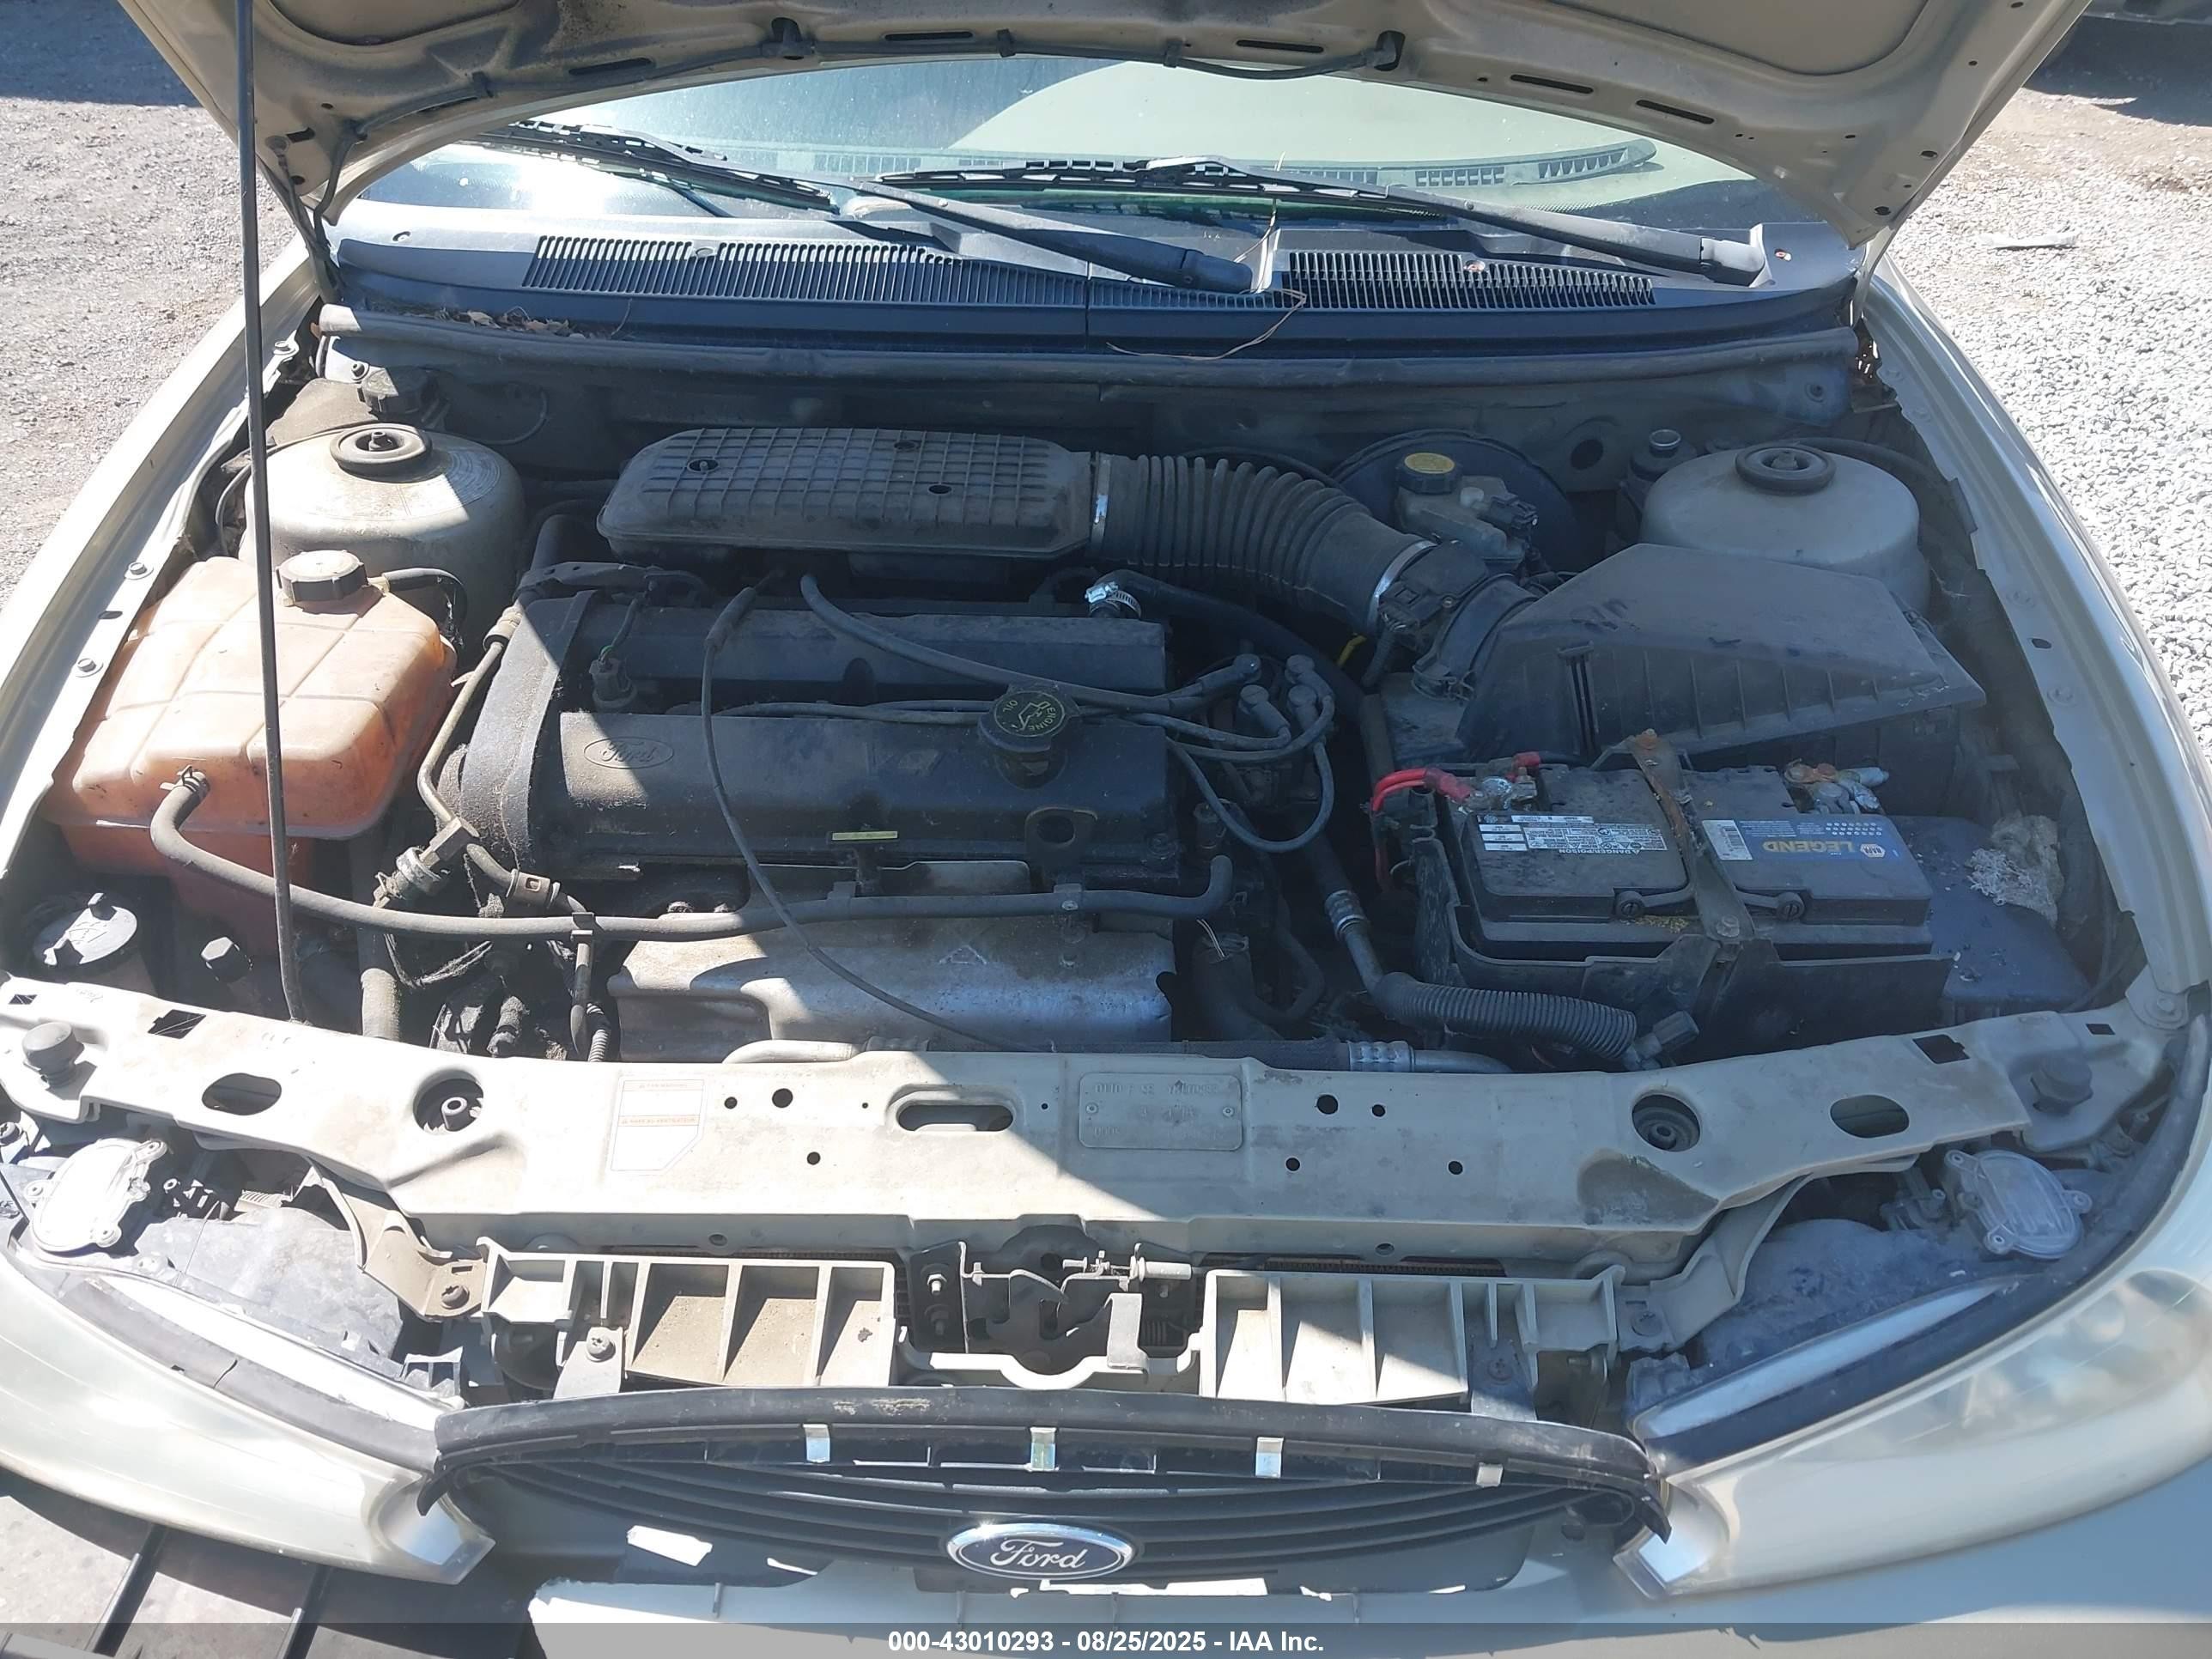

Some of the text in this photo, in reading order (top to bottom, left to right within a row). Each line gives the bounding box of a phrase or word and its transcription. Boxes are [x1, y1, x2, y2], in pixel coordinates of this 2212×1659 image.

[1003, 700, 1018, 713] OIL
[1028, 707, 1056, 731] ENGINE
[600, 740, 658, 763] Ford
[1762, 841, 1854, 853] LEGEND
[989, 1538, 1090, 1571] Ford
